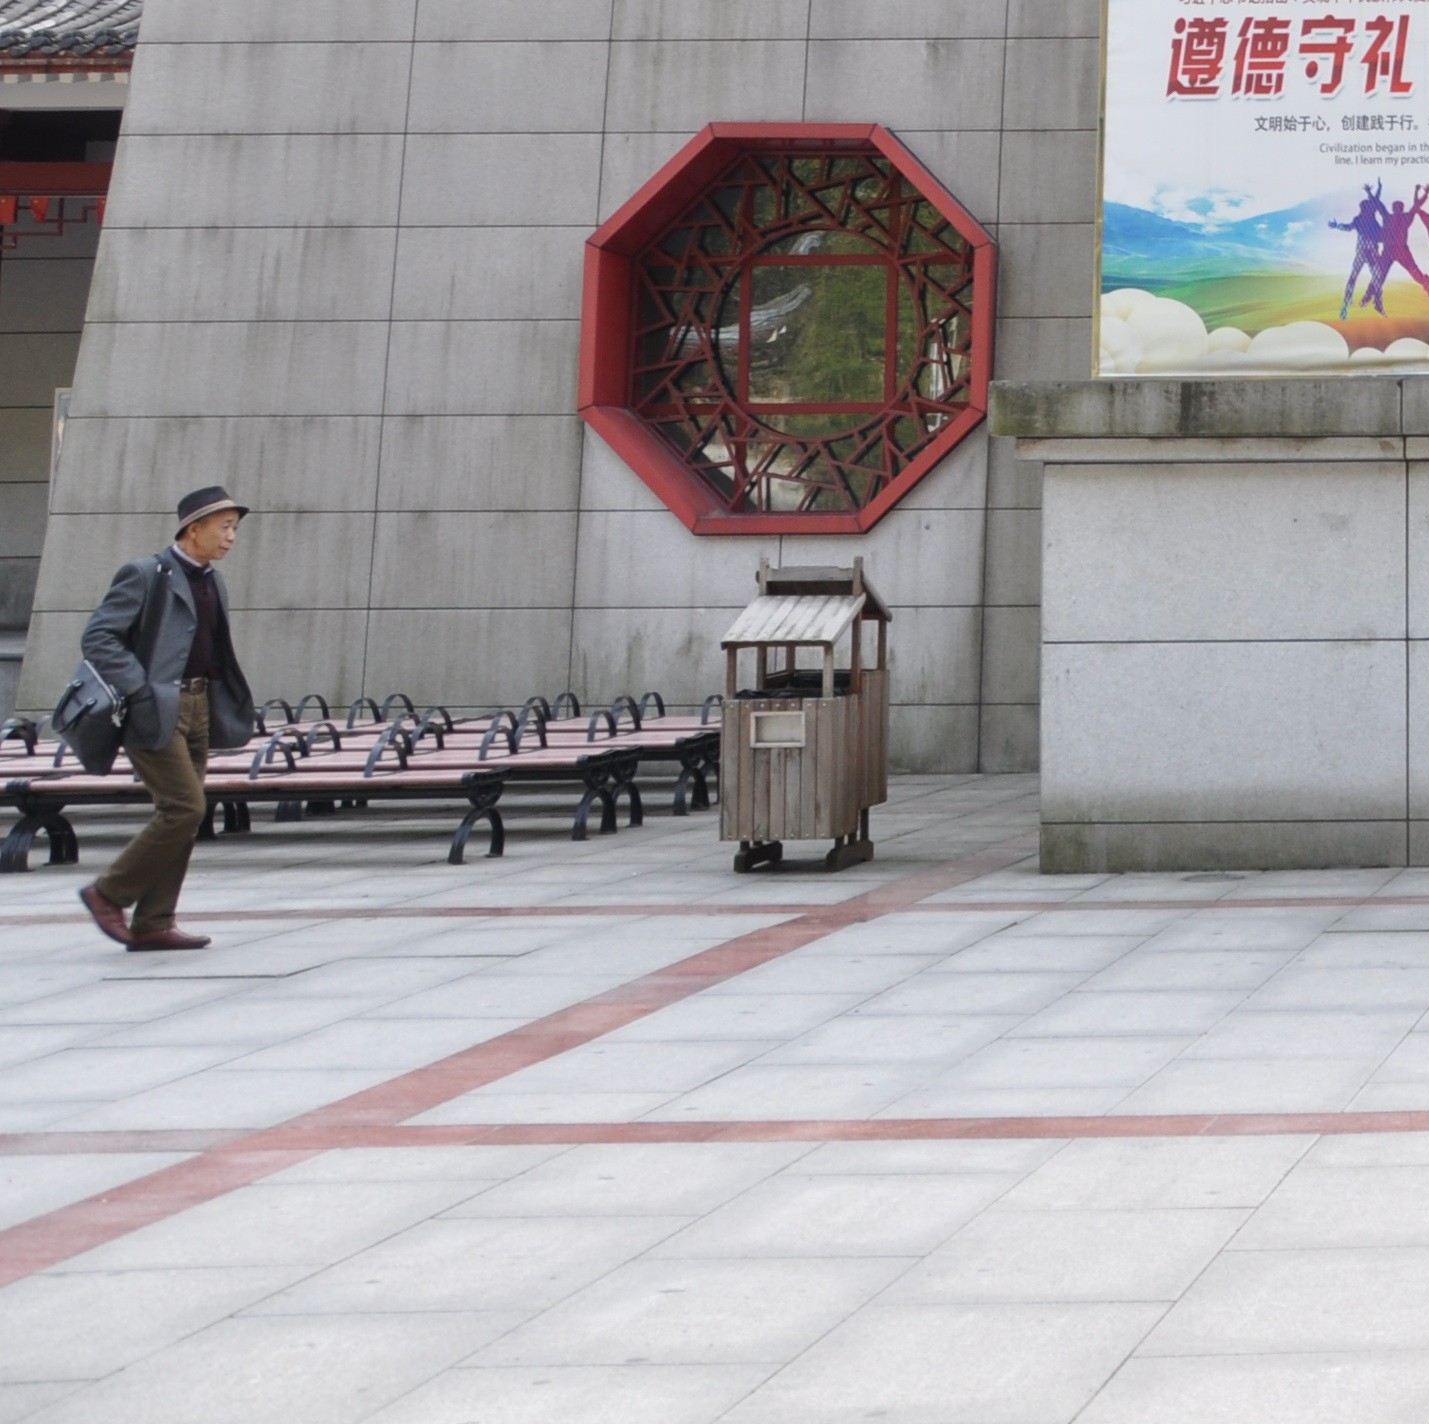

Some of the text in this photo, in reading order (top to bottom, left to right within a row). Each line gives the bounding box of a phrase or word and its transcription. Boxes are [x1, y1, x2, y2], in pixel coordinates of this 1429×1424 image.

[1166, 14, 1414, 97] 遵德守礼
[1319, 143, 1373, 153] Civilization
[1375, 142, 1405, 155] began
[1408, 142, 1417, 152] in
[1360, 155, 1383, 164] learn
[1385, 157, 1399, 166] my
